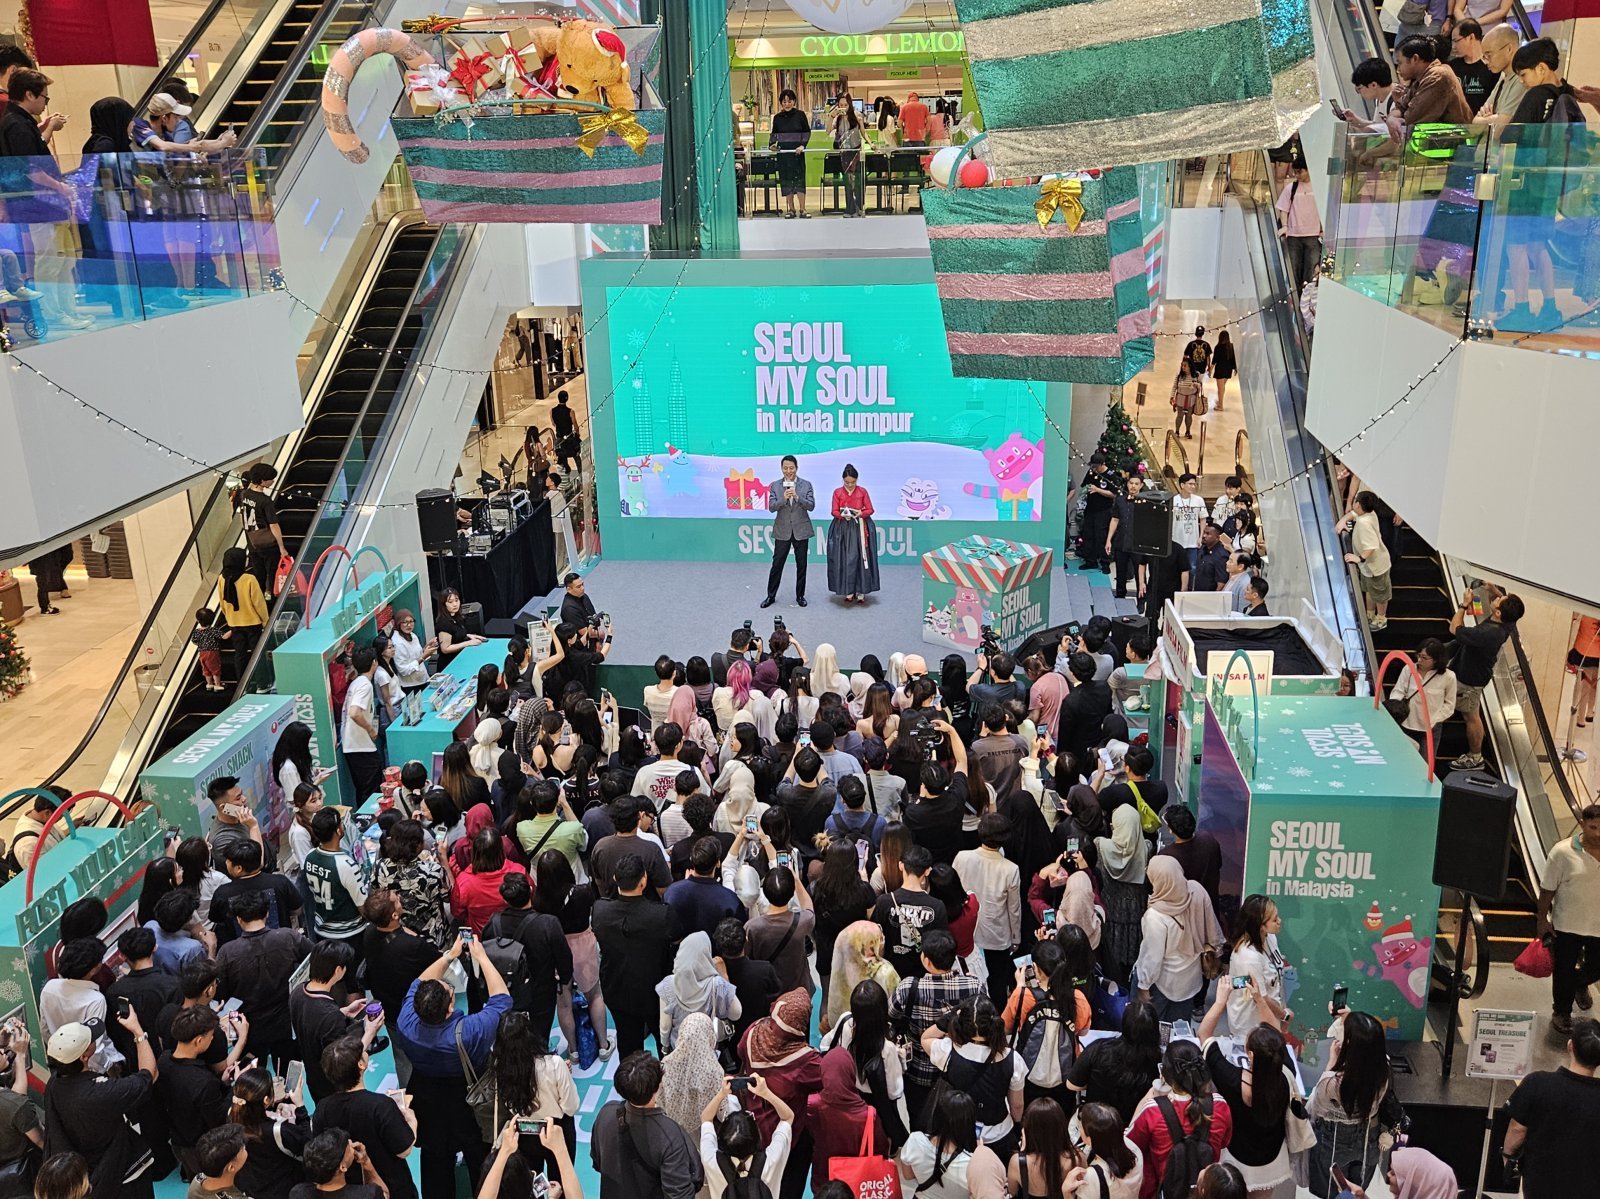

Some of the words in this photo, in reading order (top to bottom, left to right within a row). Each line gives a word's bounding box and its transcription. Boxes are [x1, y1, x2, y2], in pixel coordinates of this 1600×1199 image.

[800, 35, 869, 56] CYOU
[886, 31, 964, 54] LEMO
[754, 322, 851, 363] SEOUL
[756, 366, 808, 405] MY
[816, 365, 895, 405] SOUL
[757, 408, 775, 432] in
[780, 410, 834, 433] Kuala
[839, 410, 914, 436] Lumpur
[1002, 586, 1031, 617] SEOUL
[1001, 613, 1018, 640] MY
[1019, 602, 1042, 631] SOUL
[226, 703, 270, 723] SOUL
[226, 741, 254, 775] SNACK
[650, 784, 674, 792] Drea
[656, 776, 675, 785] Whe
[1270, 820, 1345, 850] SEOUL
[69, 839, 119, 897] YOUR
[306, 861, 331, 878] BEST
[1268, 850, 1310, 877] MY
[1315, 851, 1376, 880] SOUL
[306, 873, 334, 910] 24
[1266, 879, 1280, 895] in
[1284, 880, 1354, 899] Malaysia
[1479, 1028, 1497, 1036] SEOUL
[1498, 1029, 1527, 1038] TREASURE
